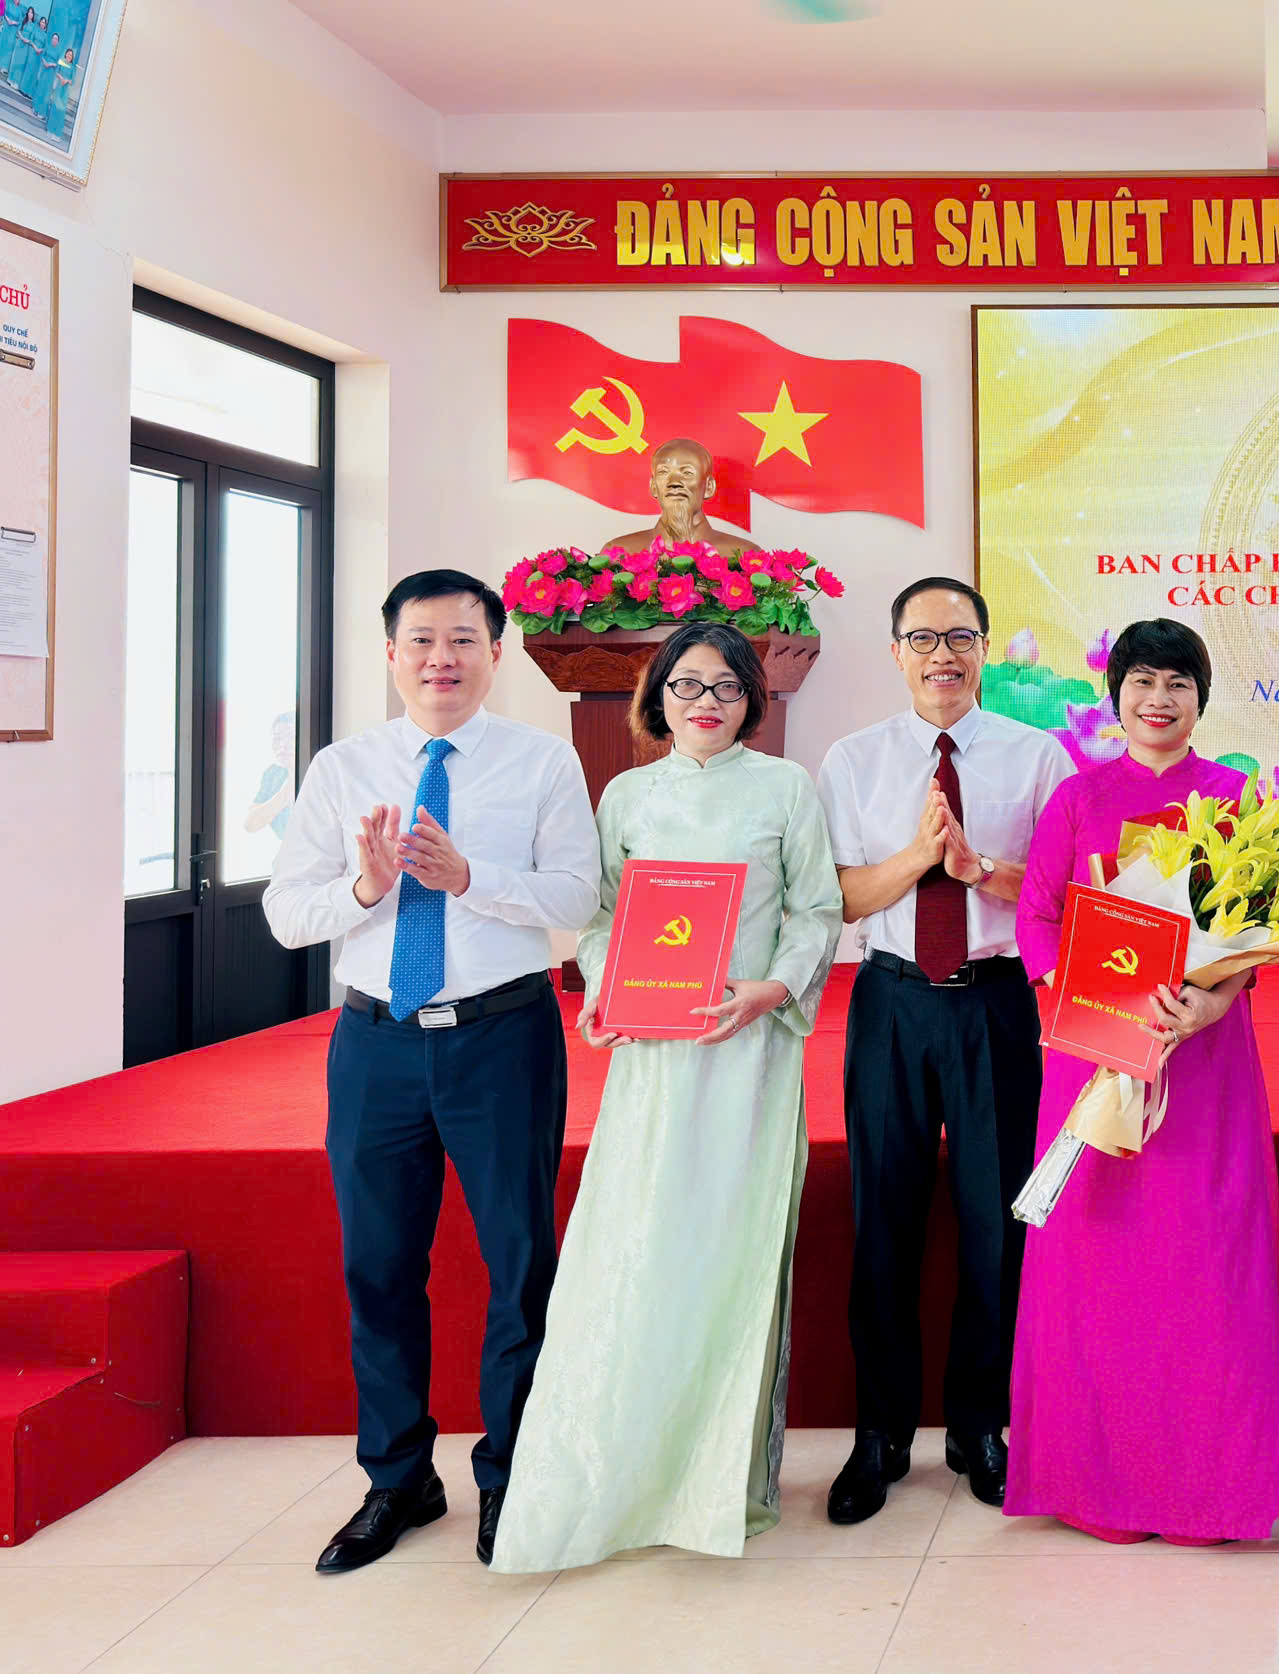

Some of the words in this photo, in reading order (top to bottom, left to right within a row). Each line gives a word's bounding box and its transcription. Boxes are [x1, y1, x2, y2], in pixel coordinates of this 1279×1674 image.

[615, 184, 756, 268] ĐẢNG
[776, 187, 914, 277] CỘNG
[935, 184, 1037, 268] SẢN
[1057, 186, 1168, 276] VIỆT
[0, 284, 31, 310] CHỦ
[1096, 553, 1161, 575] BAN
[1171, 547, 1262, 574] CHẤP
[1167, 580, 1236, 607] CÁC
